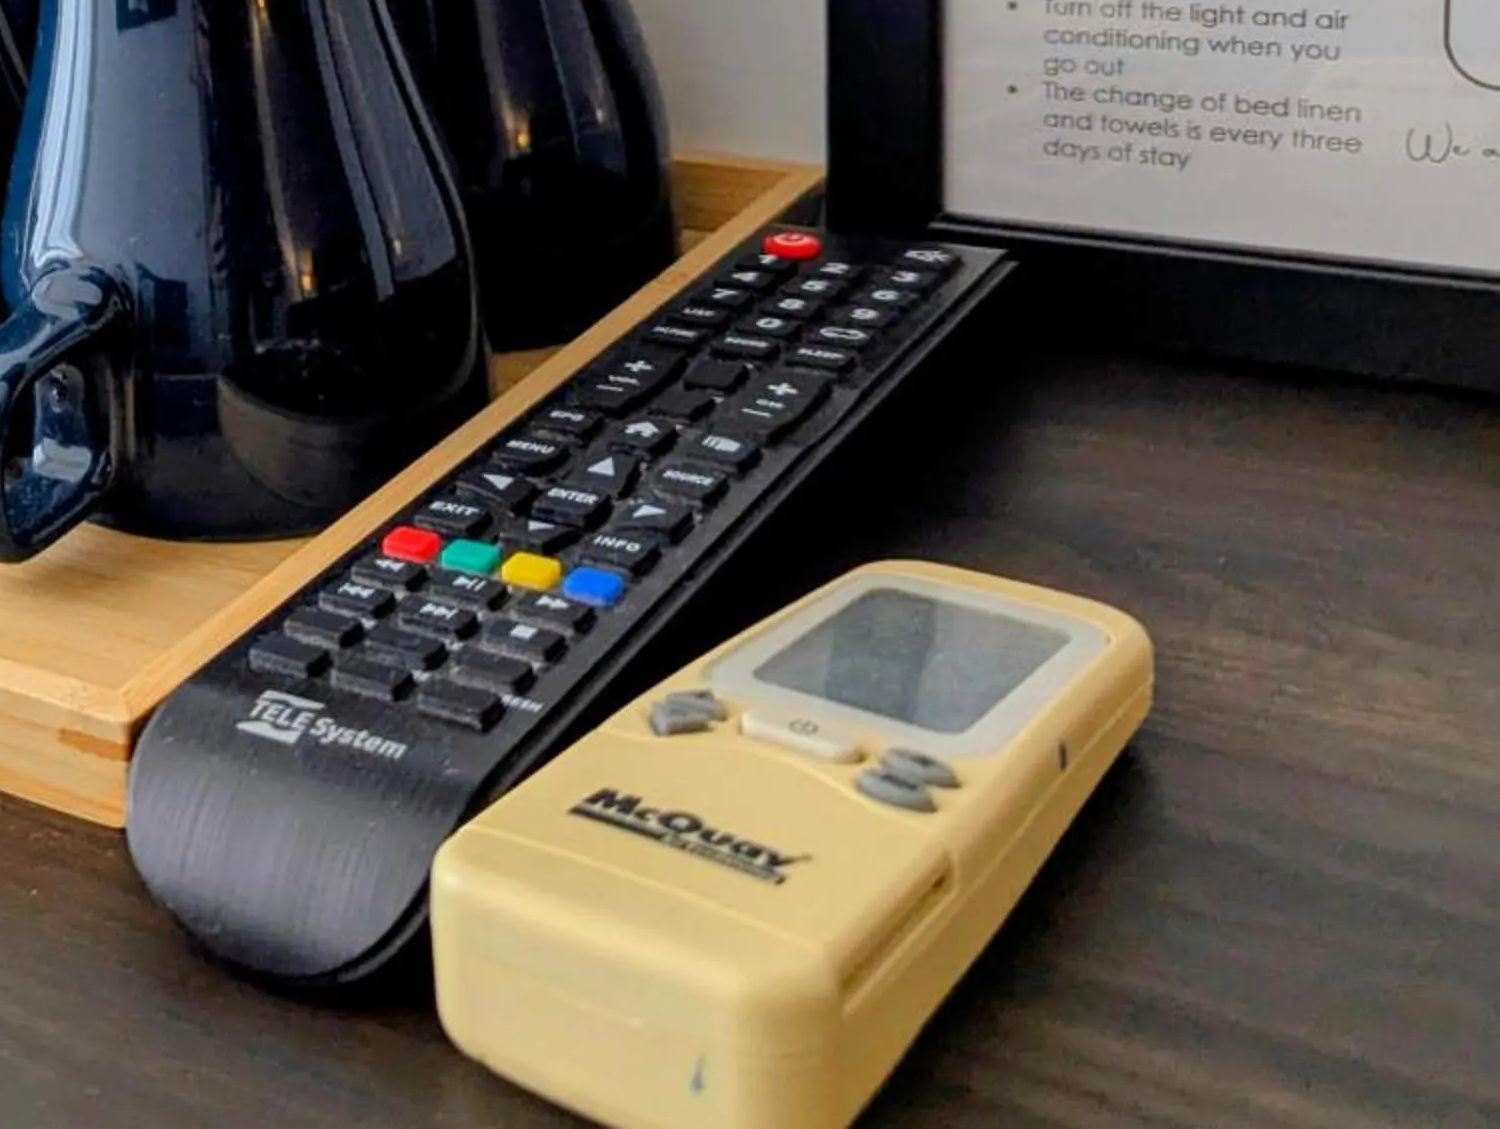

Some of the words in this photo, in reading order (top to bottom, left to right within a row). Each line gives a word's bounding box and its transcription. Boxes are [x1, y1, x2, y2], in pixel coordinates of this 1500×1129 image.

[1101, 0, 1134, 19] off
[1141, 1, 1182, 22] the
[1190, 3, 1247, 28] light
[1252, 8, 1308, 29] and
[1315, 10, 1349, 31] air
[1043, 27, 1200, 56] conditioning
[1207, 35, 1283, 58] when
[1290, 41, 1340, 62] you
[1043, 58, 1077, 77] go
[1084, 58, 1125, 77] out
[1043, 81, 1086, 102] The
[1093, 84, 1193, 114] change
[1201, 92, 1226, 113] of
[1235, 94, 1290, 118] bed
[1297, 98, 1362, 123] linen
[1043, 111, 1093, 132] and
[1101, 114, 1180, 139] towels
[1187, 120, 1203, 141] is
[1209, 124, 1283, 151] every
[1293, 130, 1363, 154] three
[1405, 121, 1470, 165] We
[1043, 139, 1101, 162] days
[1108, 142, 1135, 163] of
[1140, 145, 1190, 171] stay
[820, 262, 849, 274] 2
[801, 279, 831, 292] 5
[892, 271, 919, 283] 3
[712, 288, 739, 300] 7
[871, 289, 900, 302] 6
[778, 298, 806, 310] 8
[851, 308, 879, 320] 9
[756, 317, 784, 329] 0
[505, 439, 556, 455] MENU
[662, 470, 714, 487] SOURCE
[548, 487, 599, 505] ENTER
[429, 500, 481, 516] EXIT
[594, 535, 642, 552] INFO
[250, 698, 315, 731] TELE
[310, 717, 408, 760] System
